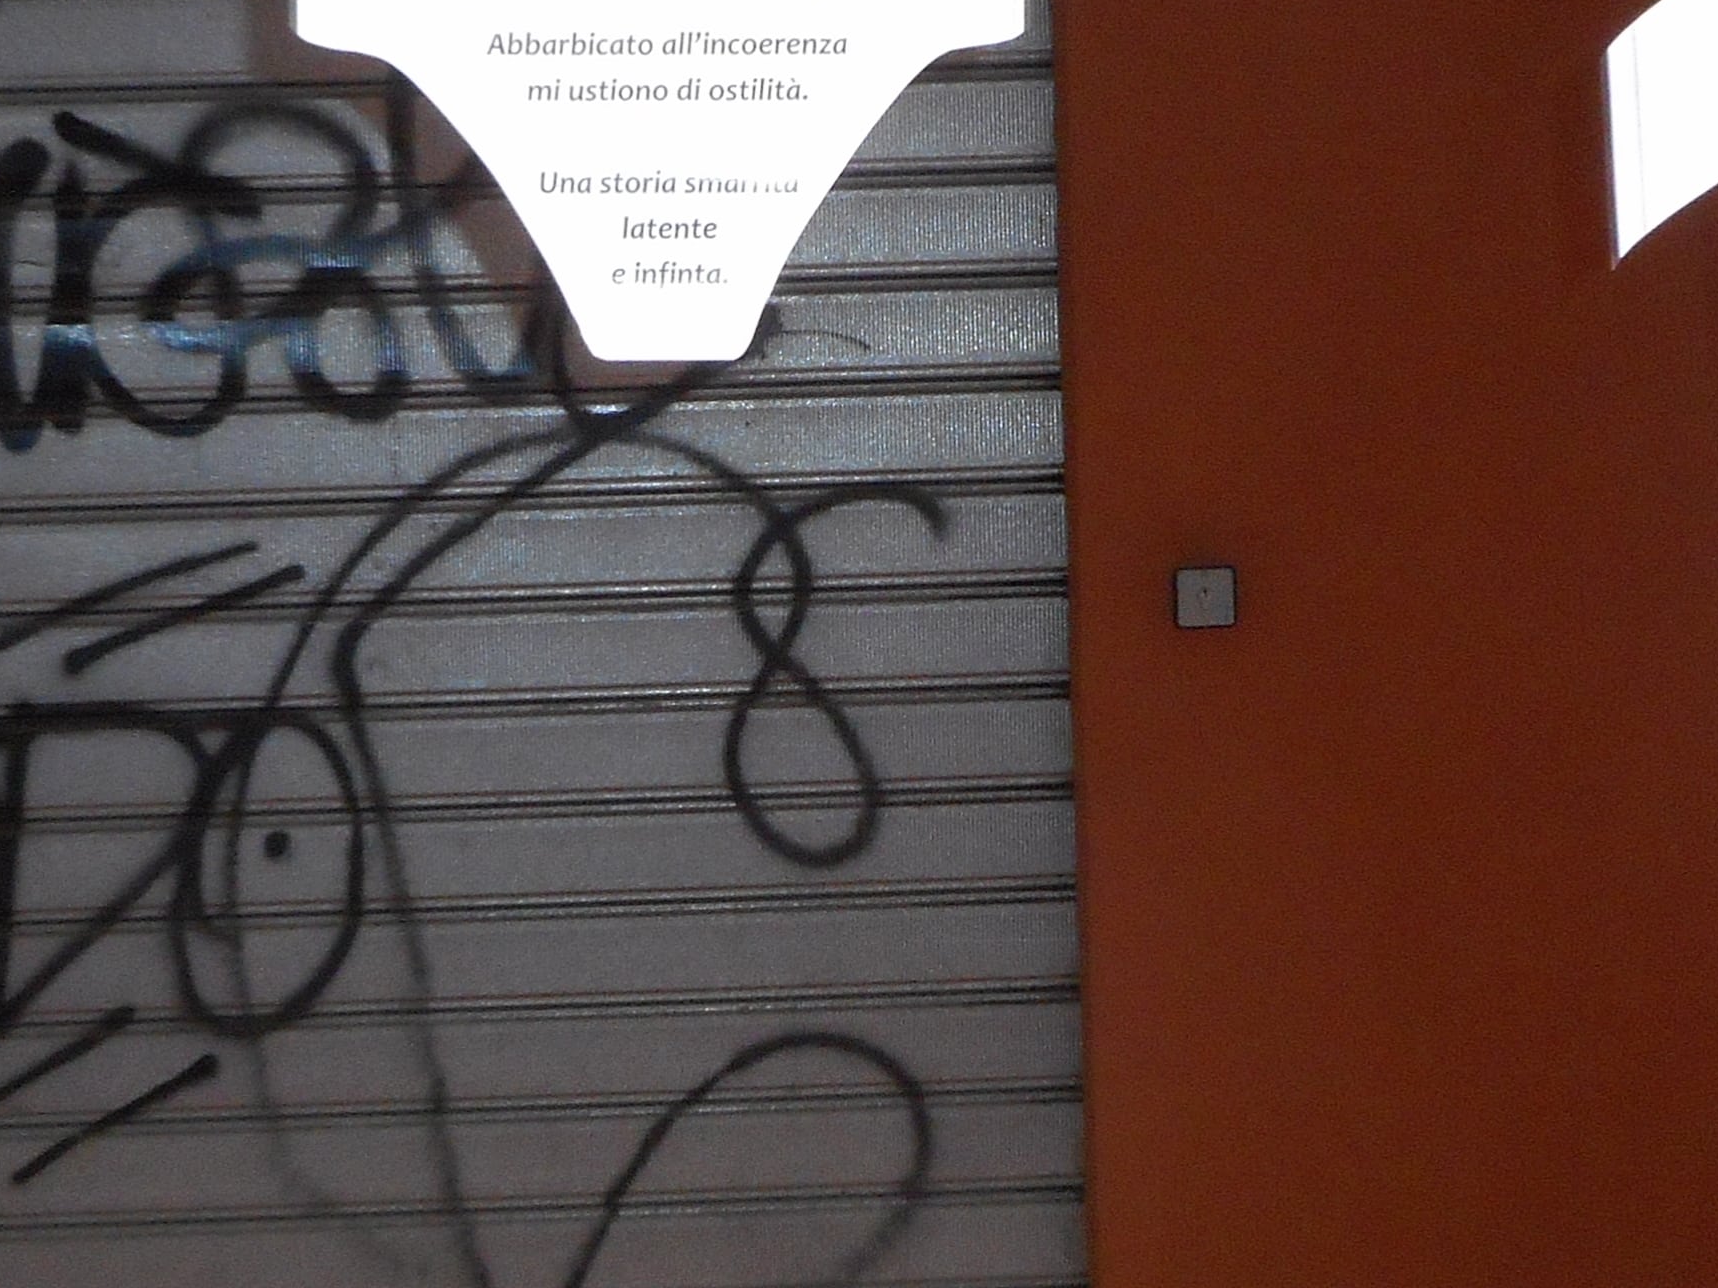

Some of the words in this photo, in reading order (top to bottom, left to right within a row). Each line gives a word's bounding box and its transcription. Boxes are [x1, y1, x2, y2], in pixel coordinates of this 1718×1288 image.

[486, 31, 654, 56] Abbarbicato
[527, 78, 562, 102] mi
[568, 77, 669, 102] ustiono
[676, 77, 702, 102] di
[708, 77, 809, 102] ostilità.
[539, 171, 592, 195] Una
[599, 169, 677, 195] storia
[622, 215, 718, 240] latente
[611, 267, 627, 285] e
[634, 260, 728, 289] infinta.
